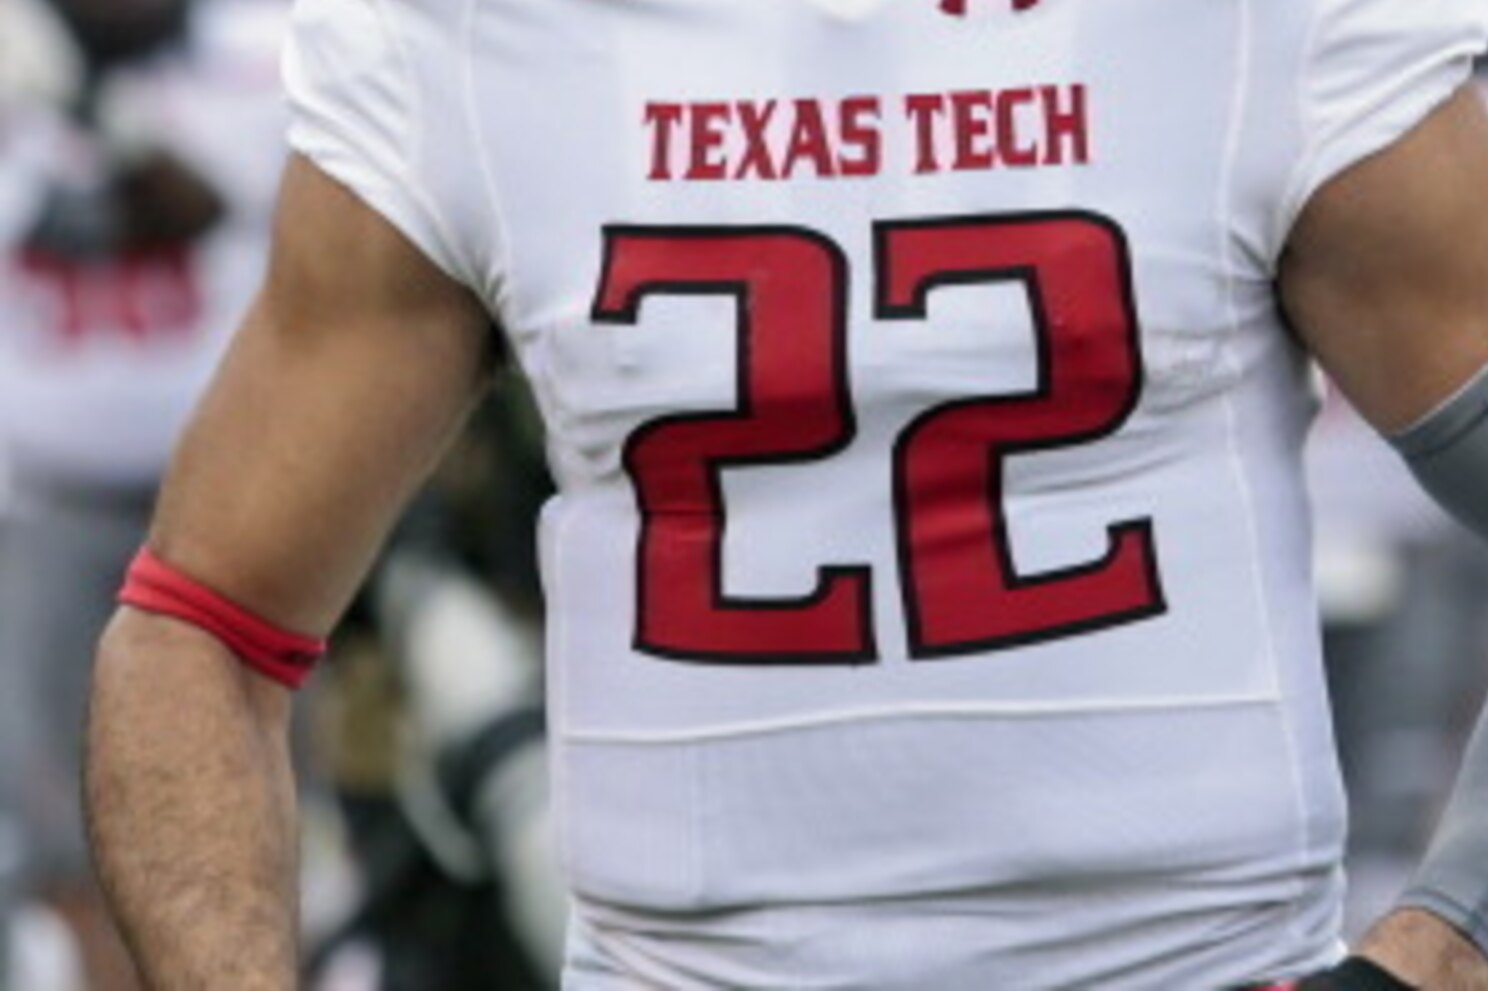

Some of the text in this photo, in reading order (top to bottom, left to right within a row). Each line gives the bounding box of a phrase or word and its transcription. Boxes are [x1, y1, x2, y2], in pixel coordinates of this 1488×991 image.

[645, 84, 1090, 181] TEXAS TECH
[590, 209, 1167, 666] 22
